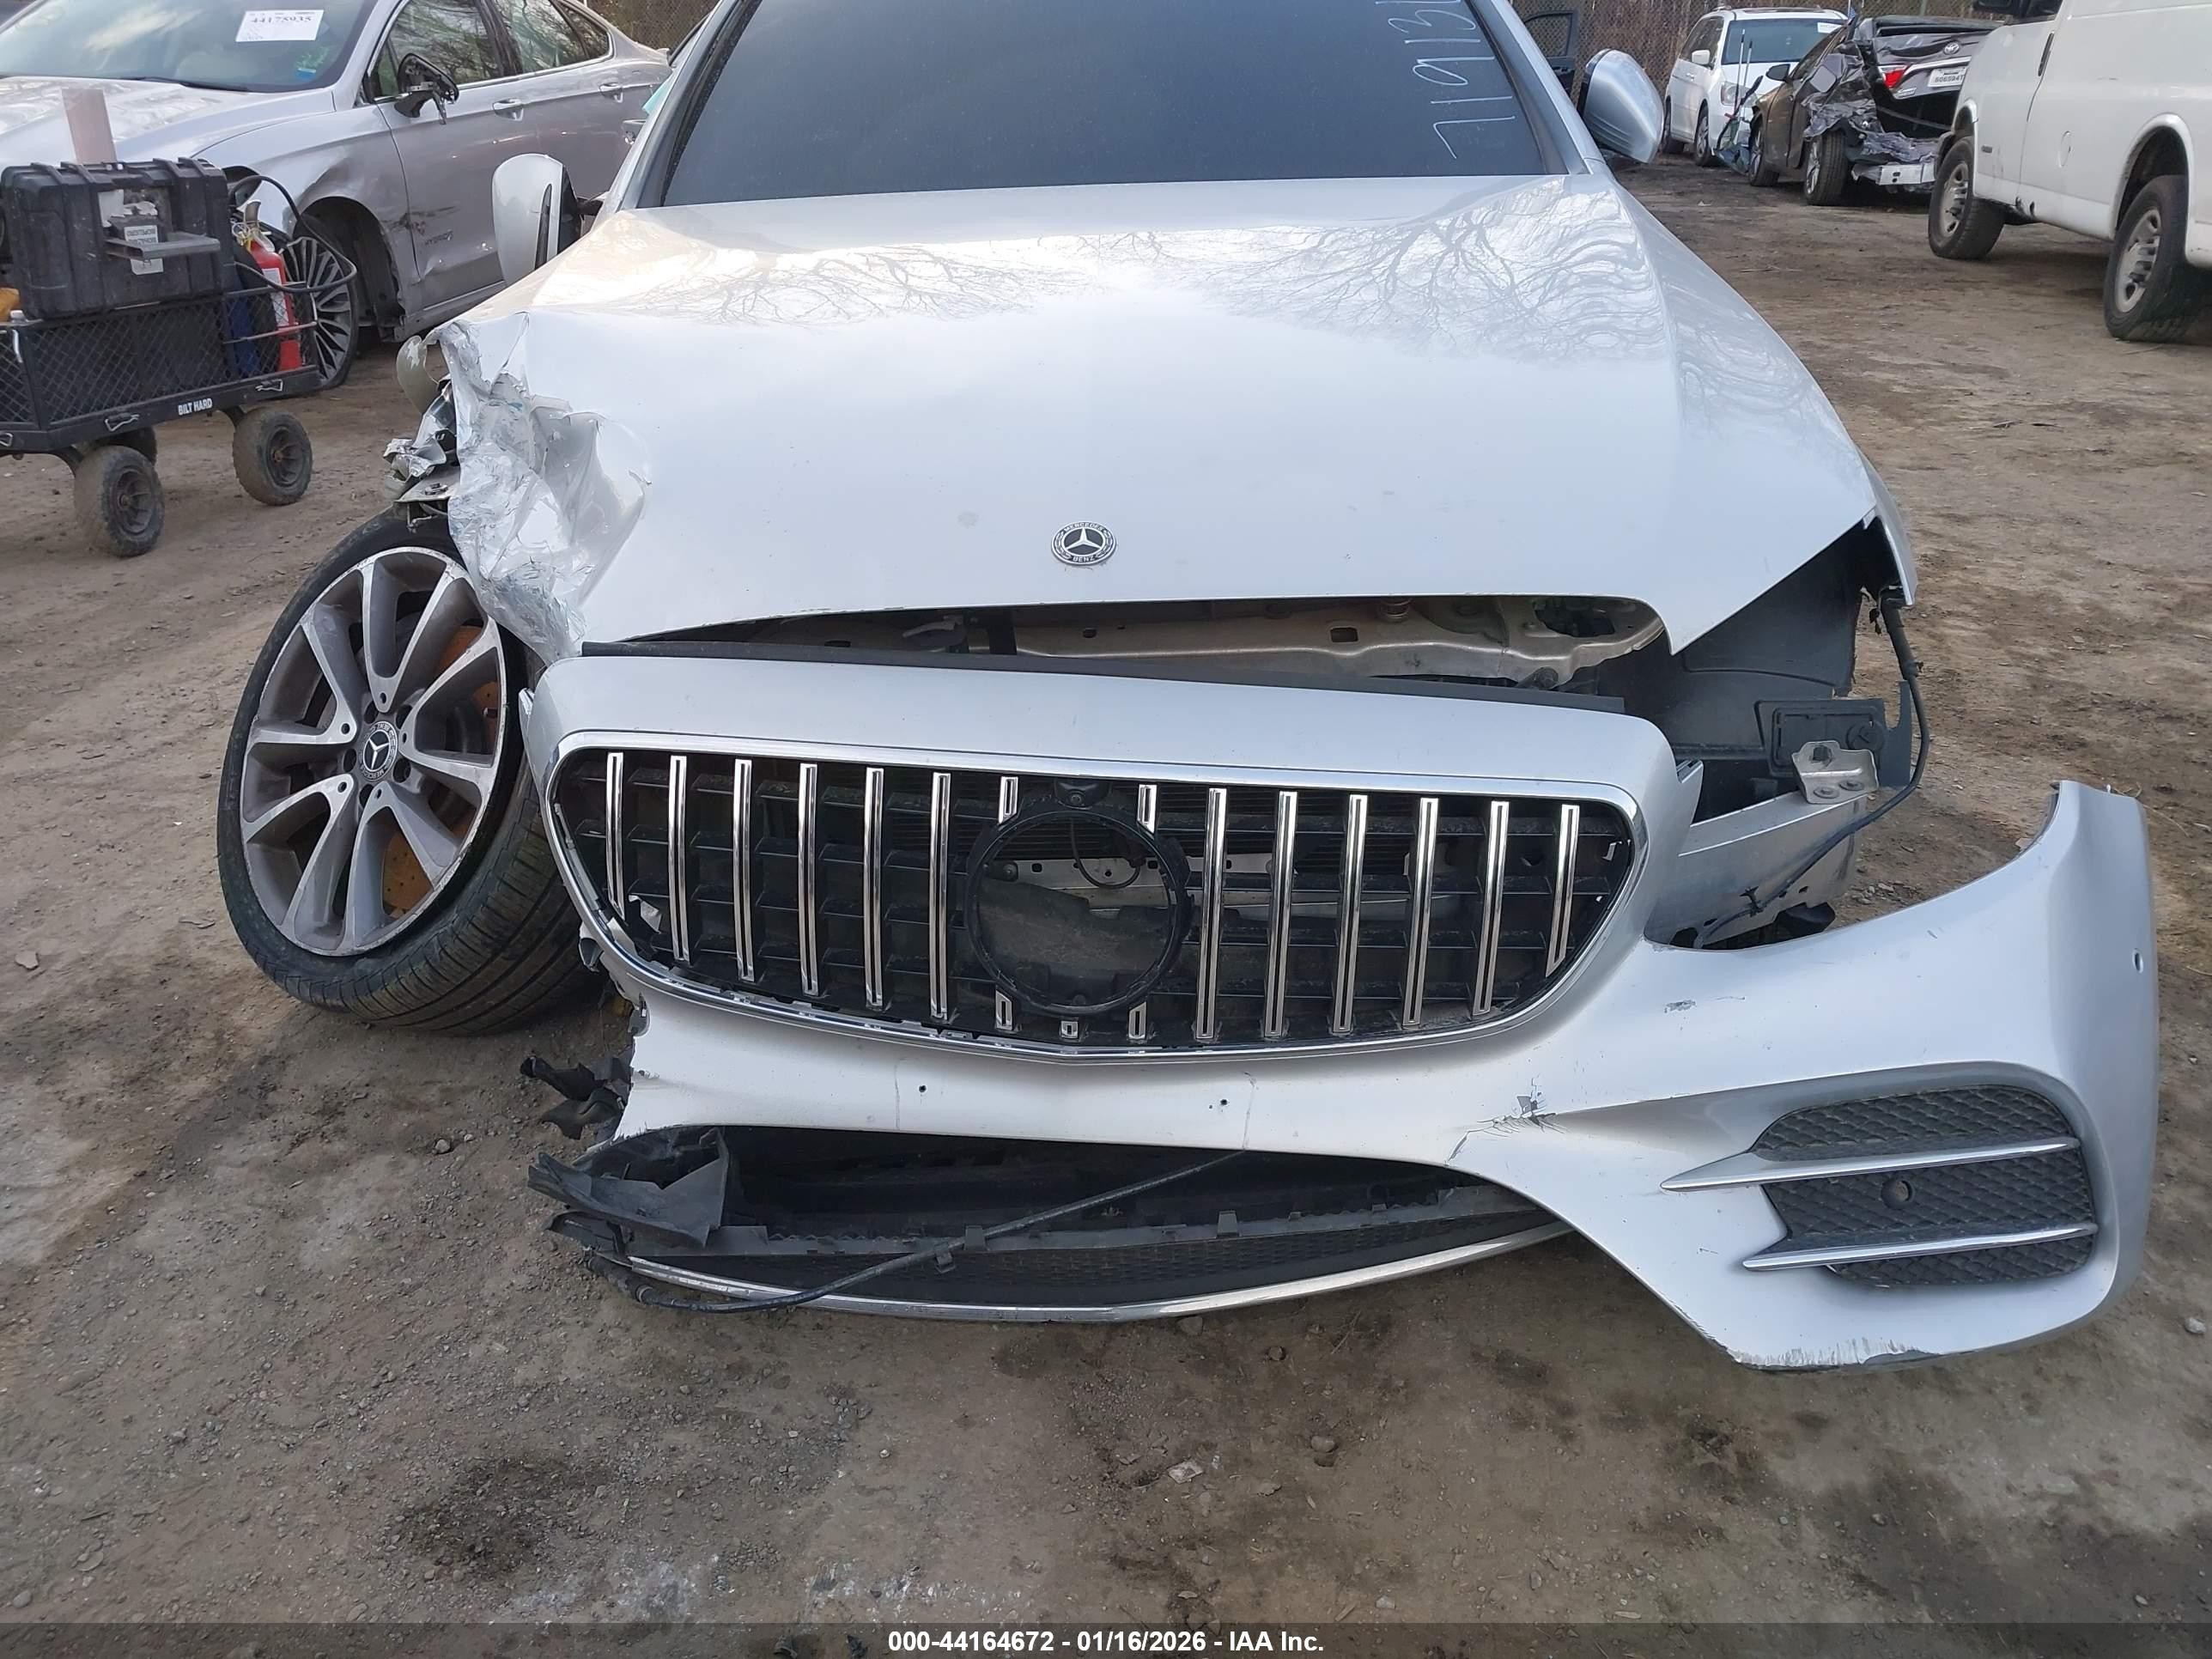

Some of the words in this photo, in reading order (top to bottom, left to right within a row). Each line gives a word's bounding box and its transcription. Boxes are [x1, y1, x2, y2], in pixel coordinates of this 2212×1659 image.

[1375, 0, 1516, 159] 71913
[178, 402, 192, 416] BILT
[193, 398, 213, 412] HARD
[1063, 522, 1103, 532] MERCEDES
